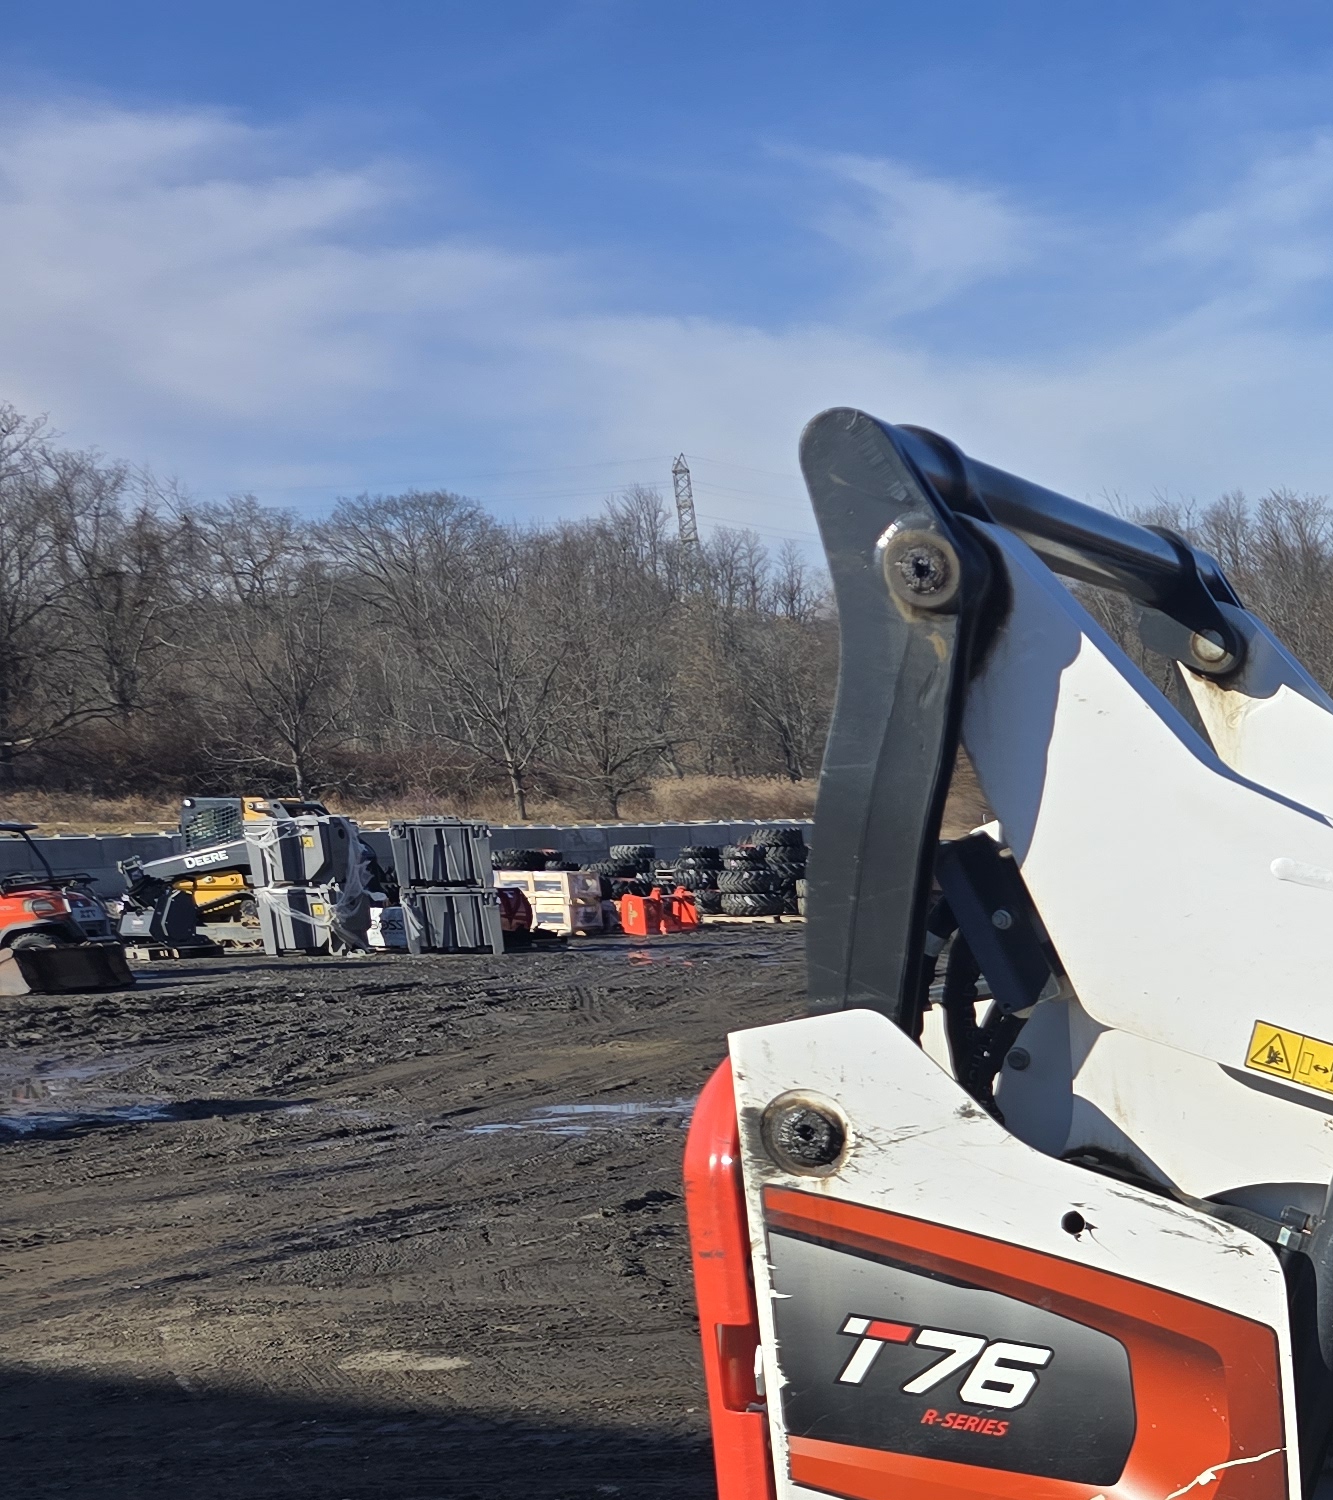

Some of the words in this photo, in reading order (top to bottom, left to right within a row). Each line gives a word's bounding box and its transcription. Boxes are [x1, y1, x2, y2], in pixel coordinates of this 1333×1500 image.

[184, 850, 229, 869] DEERE
[836, 1313, 1054, 1411] T76
[920, 1408, 1010, 1437] R-SERIES
